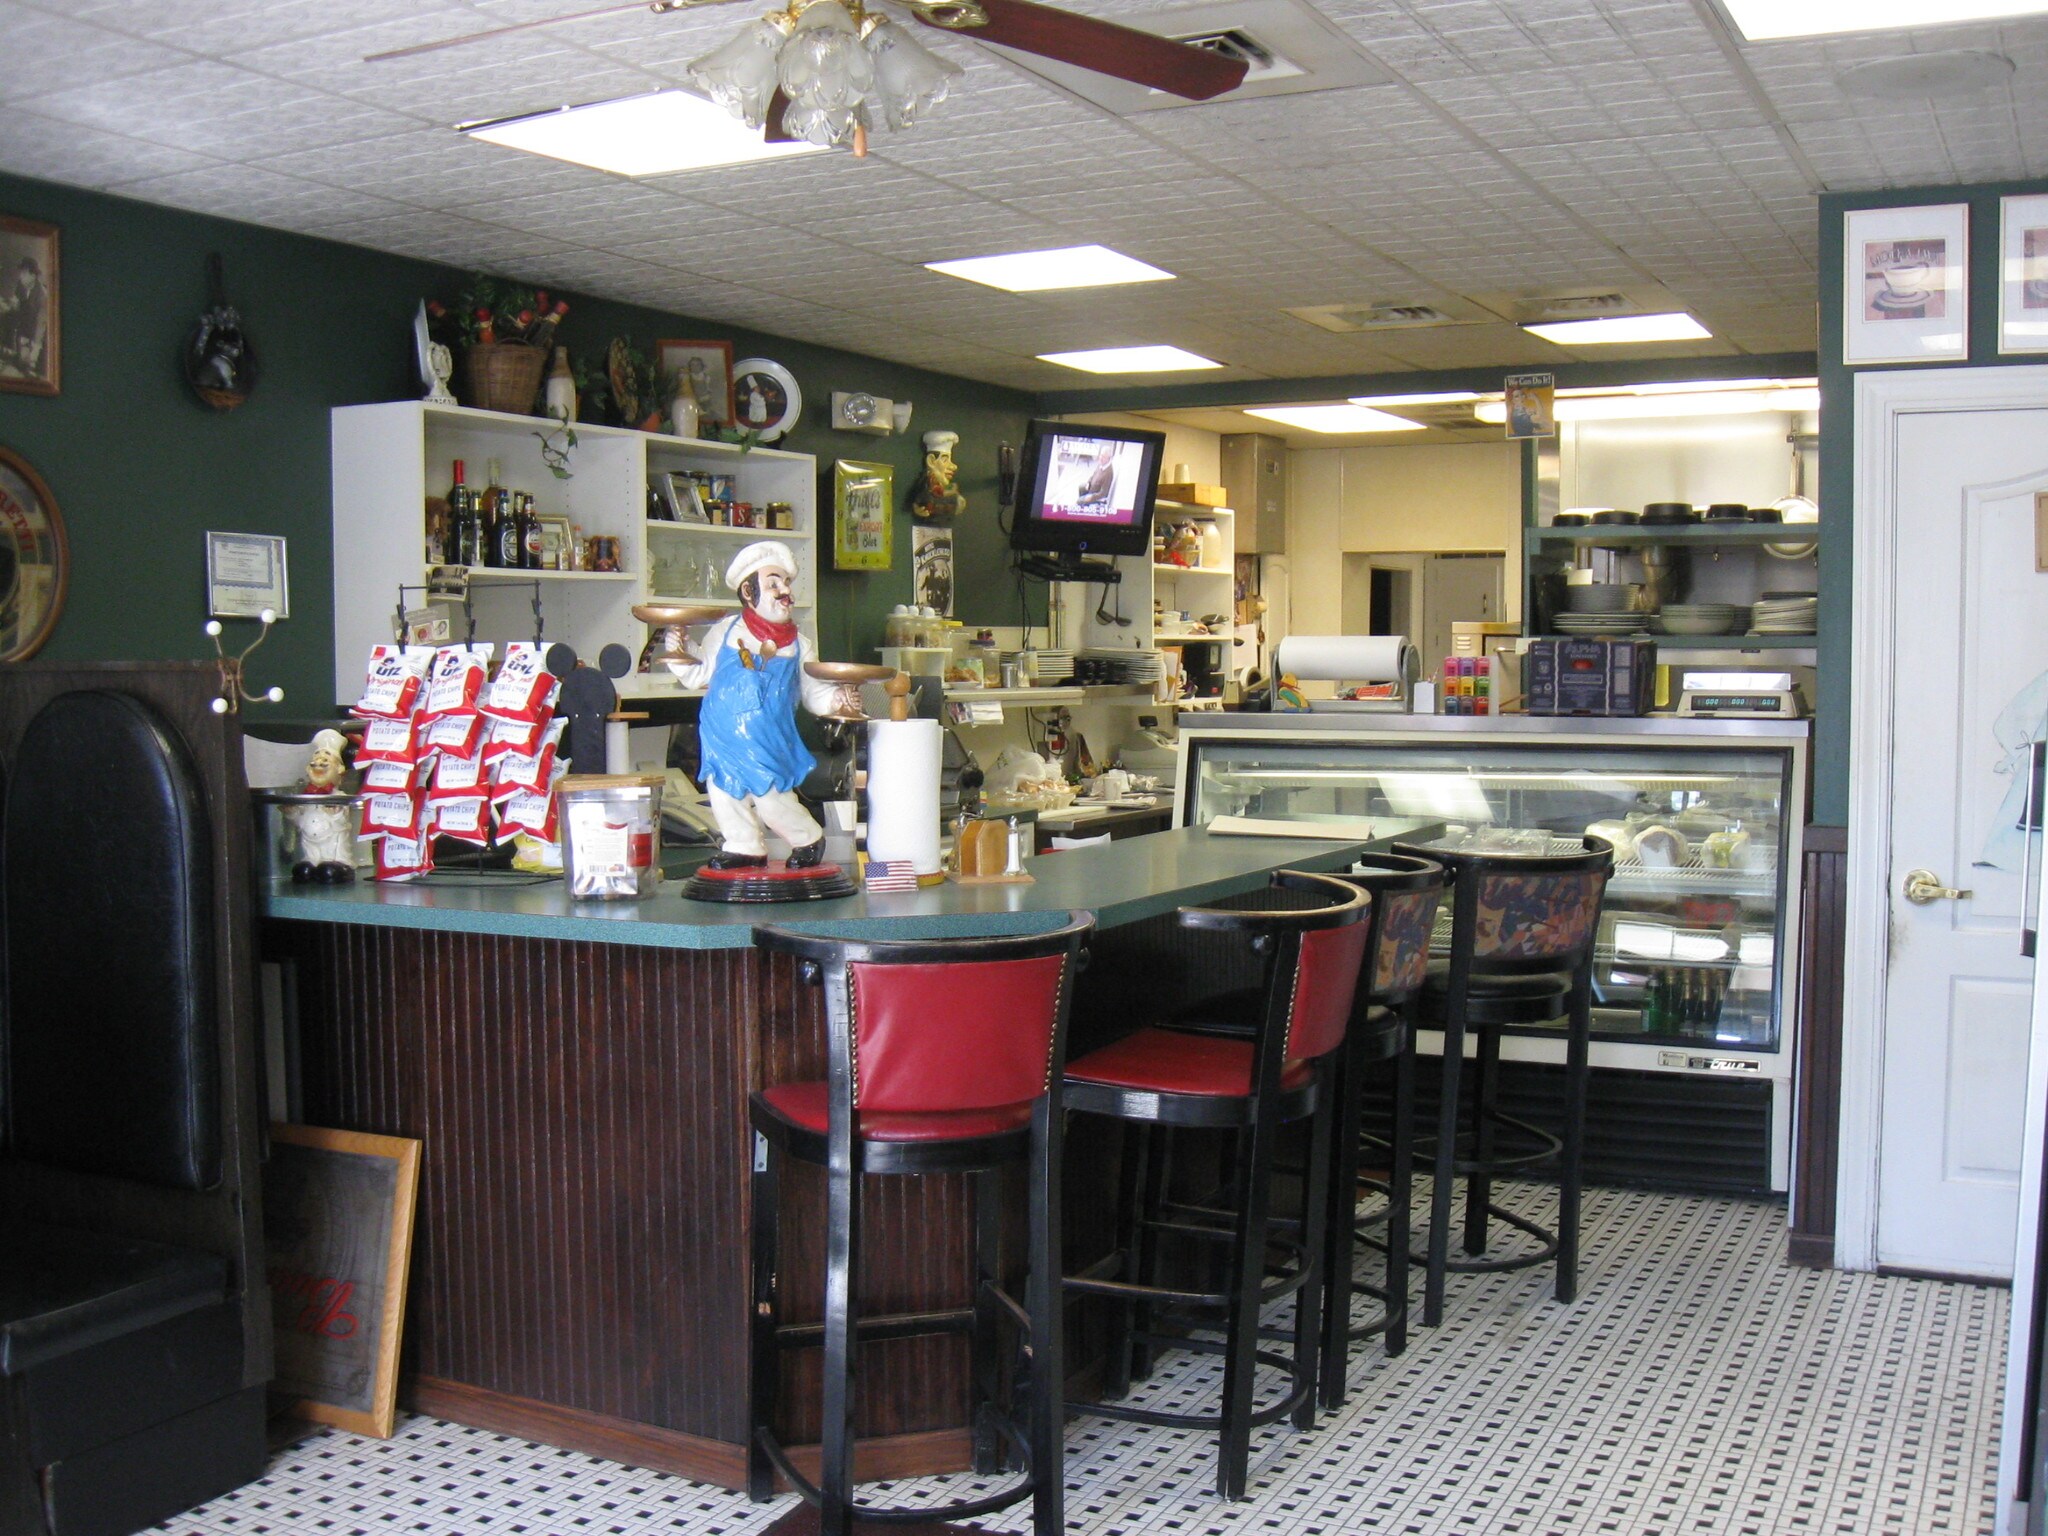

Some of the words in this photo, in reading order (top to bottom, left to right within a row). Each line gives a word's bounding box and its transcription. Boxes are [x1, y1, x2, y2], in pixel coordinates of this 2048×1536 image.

[1532, 376, 1543, 385] Do
[374, 800, 393, 809] POTATO
[393, 802, 411, 811] CHIPS
